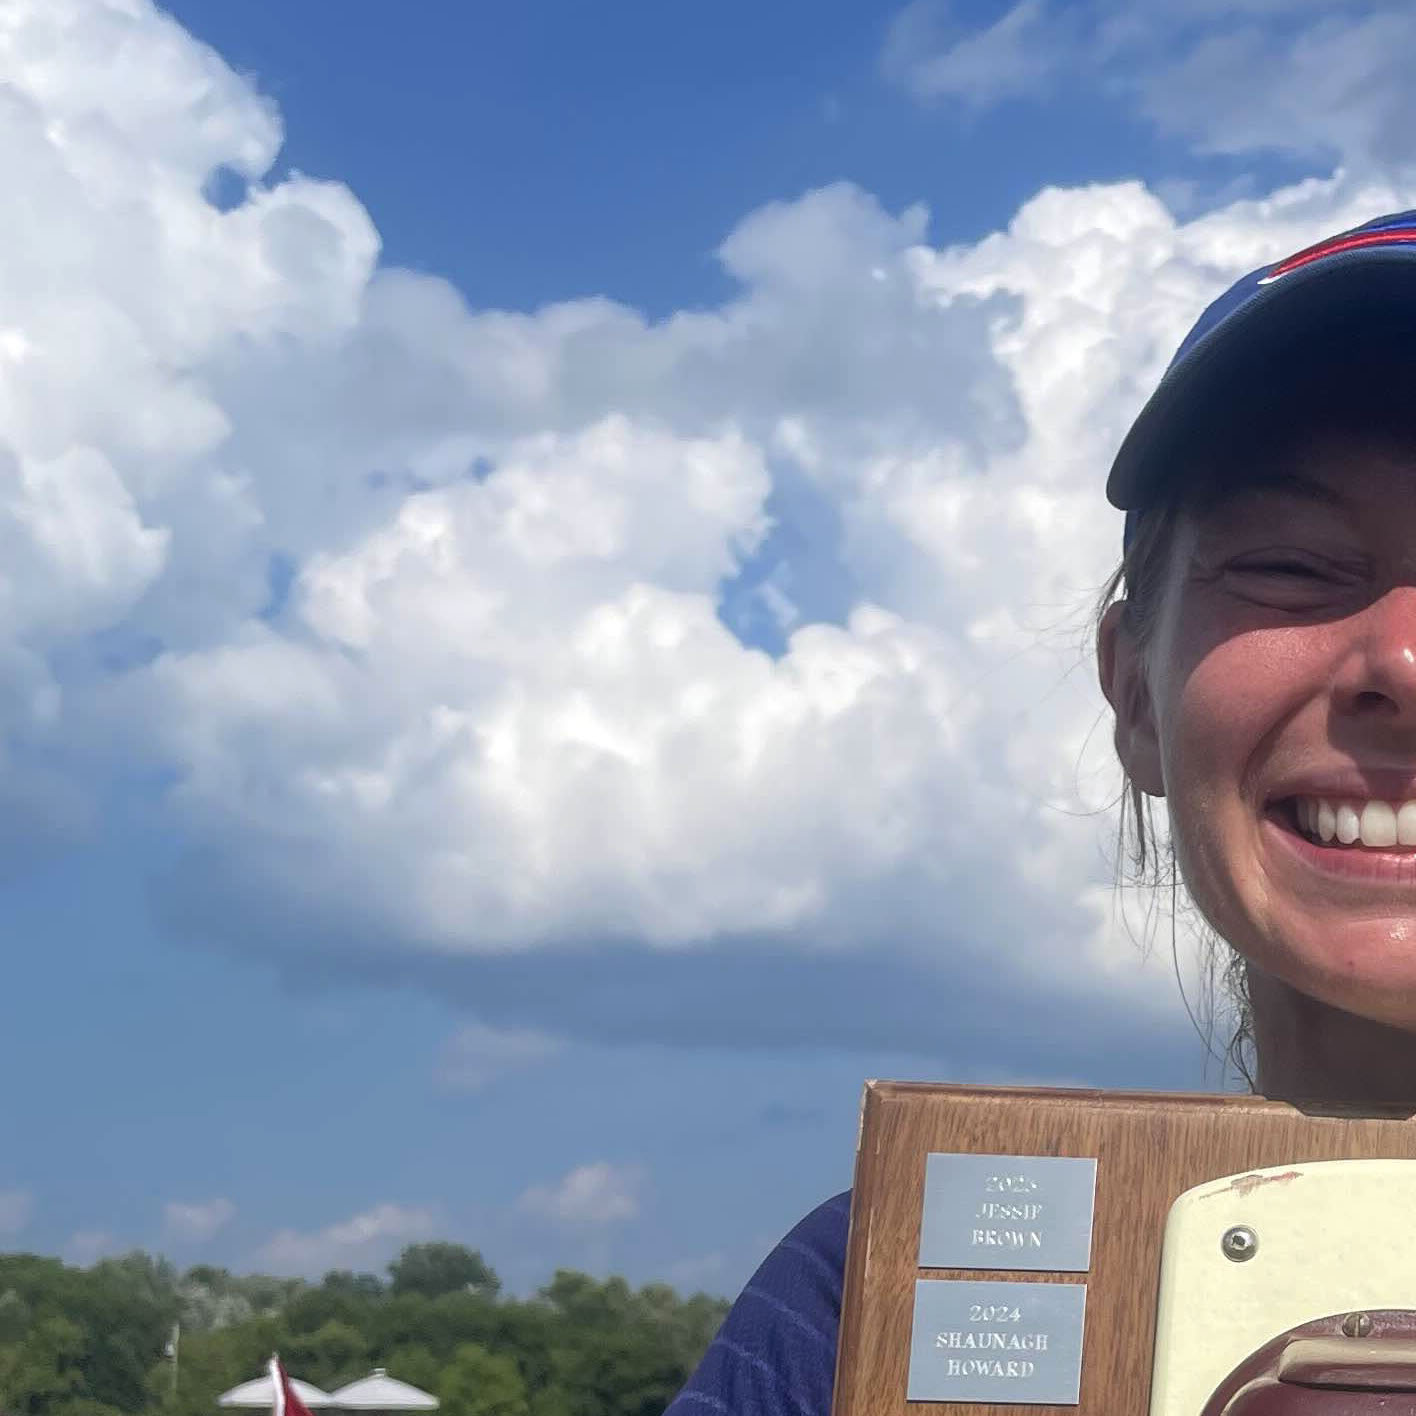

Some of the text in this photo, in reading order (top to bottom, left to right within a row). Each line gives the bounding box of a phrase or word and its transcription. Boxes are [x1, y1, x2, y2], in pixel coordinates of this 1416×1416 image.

[975, 1203, 1042, 1220] JESSIE
[972, 1229, 1042, 1248] BROWN
[968, 1305, 1022, 1323] 2024
[935, 1332, 1048, 1351] SHAUNAGH
[946, 1359, 1034, 1378] HOWARD
